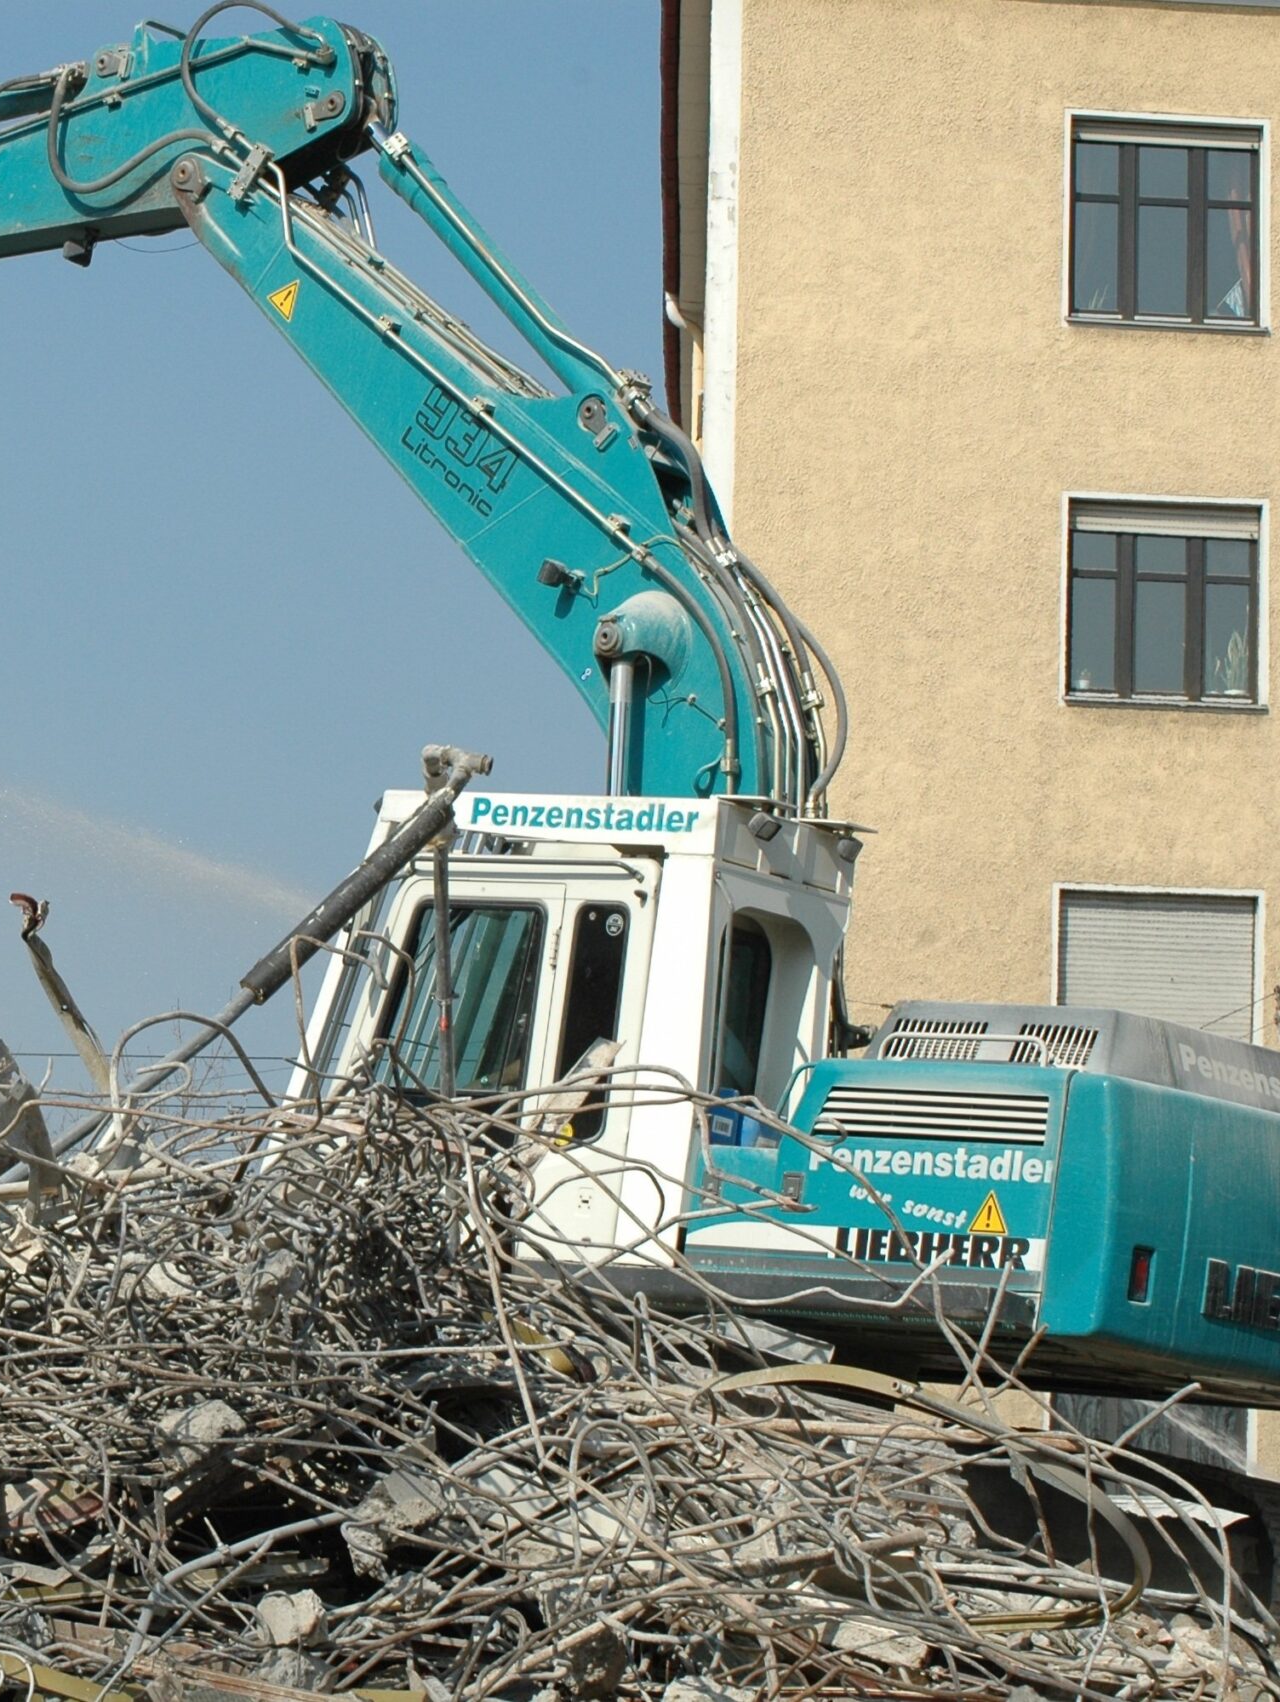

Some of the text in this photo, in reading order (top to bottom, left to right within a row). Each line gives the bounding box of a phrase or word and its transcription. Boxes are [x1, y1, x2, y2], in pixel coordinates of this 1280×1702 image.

[416, 384, 519, 493] 934
[400, 426, 493, 517] Litronic
[471, 797, 699, 832] Penzenstadler
[901, 1199, 968, 1229] sonst
[834, 1227, 1031, 1271] LIEBHERR
